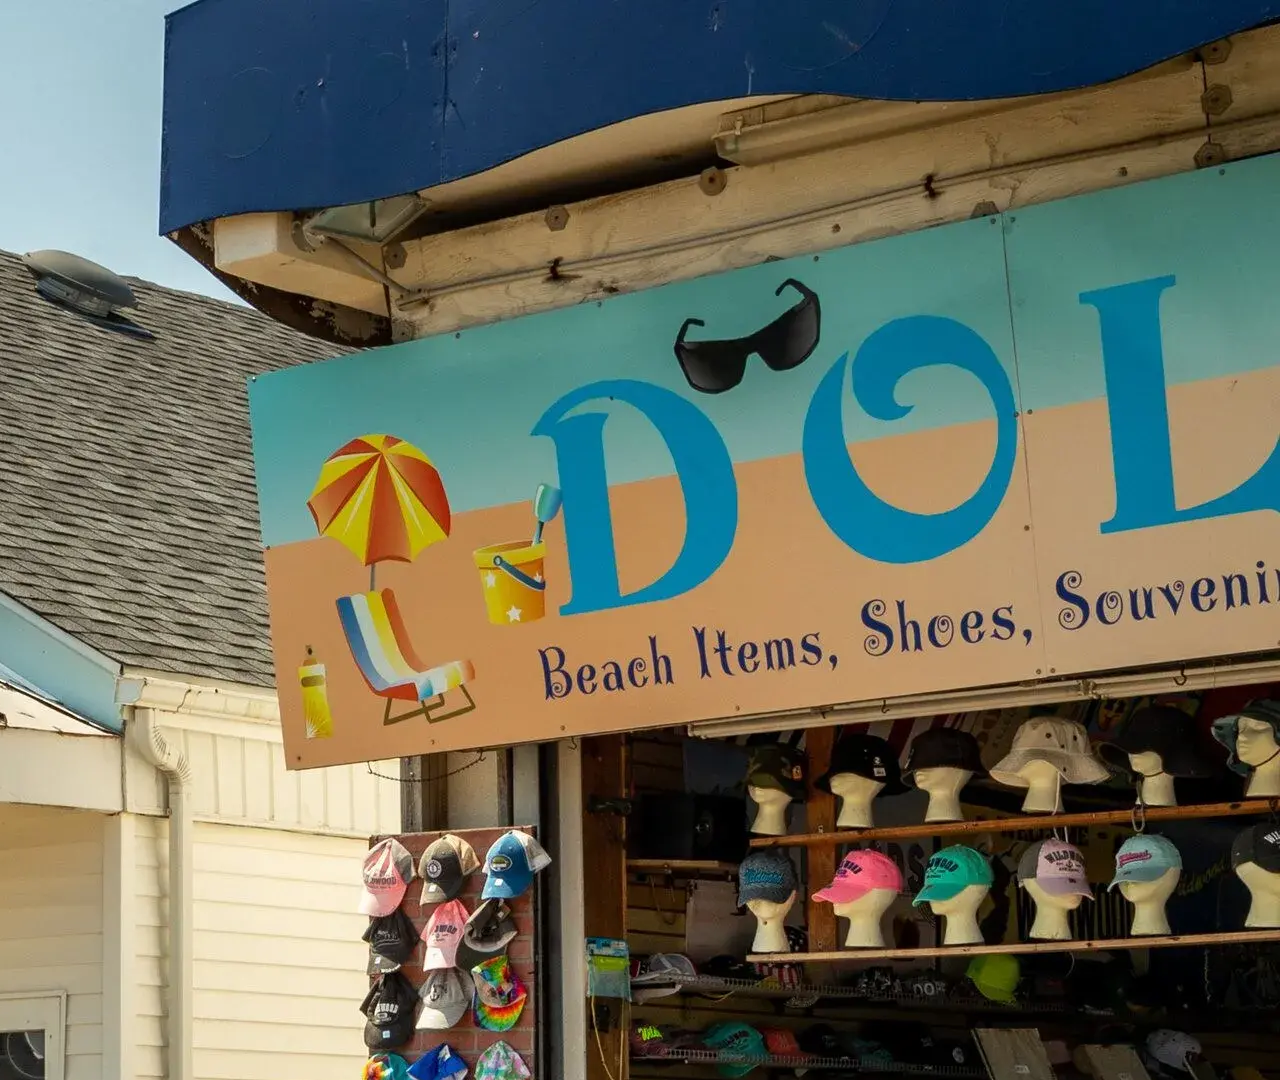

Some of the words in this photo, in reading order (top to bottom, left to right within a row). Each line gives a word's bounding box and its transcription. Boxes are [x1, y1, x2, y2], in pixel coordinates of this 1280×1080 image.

[541, 634, 676, 702] Beach
[690, 625, 840, 681] Items,
[859, 597, 1034, 660] Shoes,
[1054, 555, 1280, 632] Souveni
